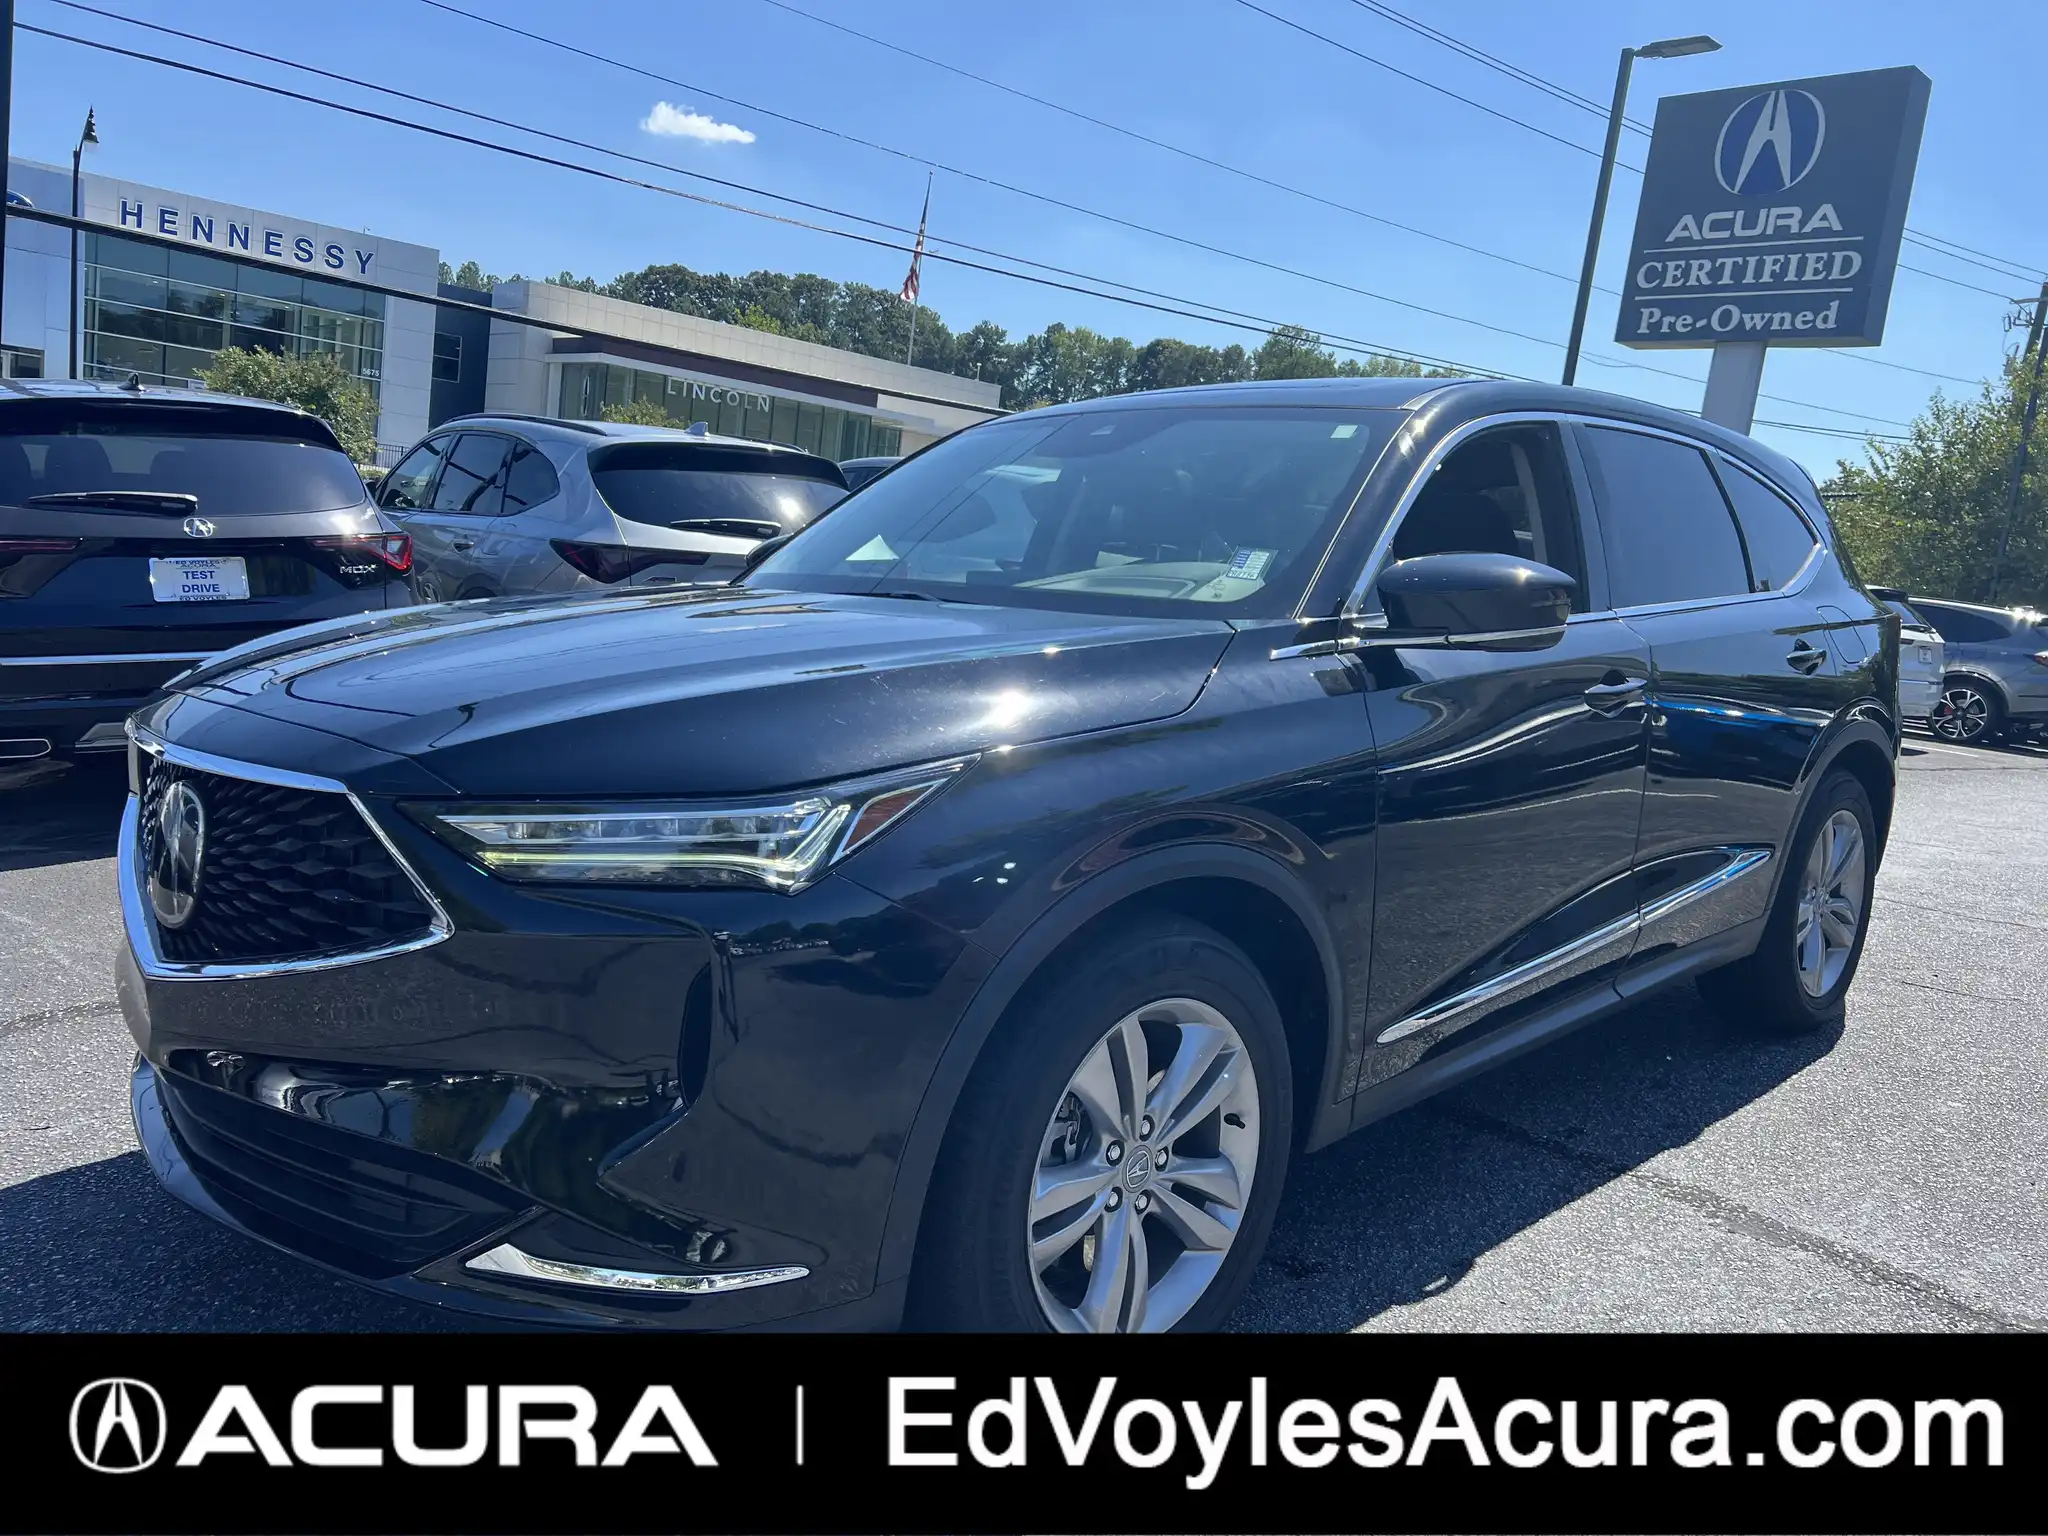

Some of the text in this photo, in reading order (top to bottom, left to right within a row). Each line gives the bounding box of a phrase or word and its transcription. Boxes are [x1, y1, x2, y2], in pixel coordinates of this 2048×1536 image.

[119, 198, 375, 276] HENNESSY
[1664, 202, 1844, 243] ACURA
[1636, 250, 1863, 289] CERTIFIED
[1636, 300, 1840, 334] Pre-Owned
[667, 376, 770, 413] LINCOLN
[182, 570, 215, 580] TEST
[340, 564, 377, 574] MDX
[181, 583, 221, 593] DRIVE
